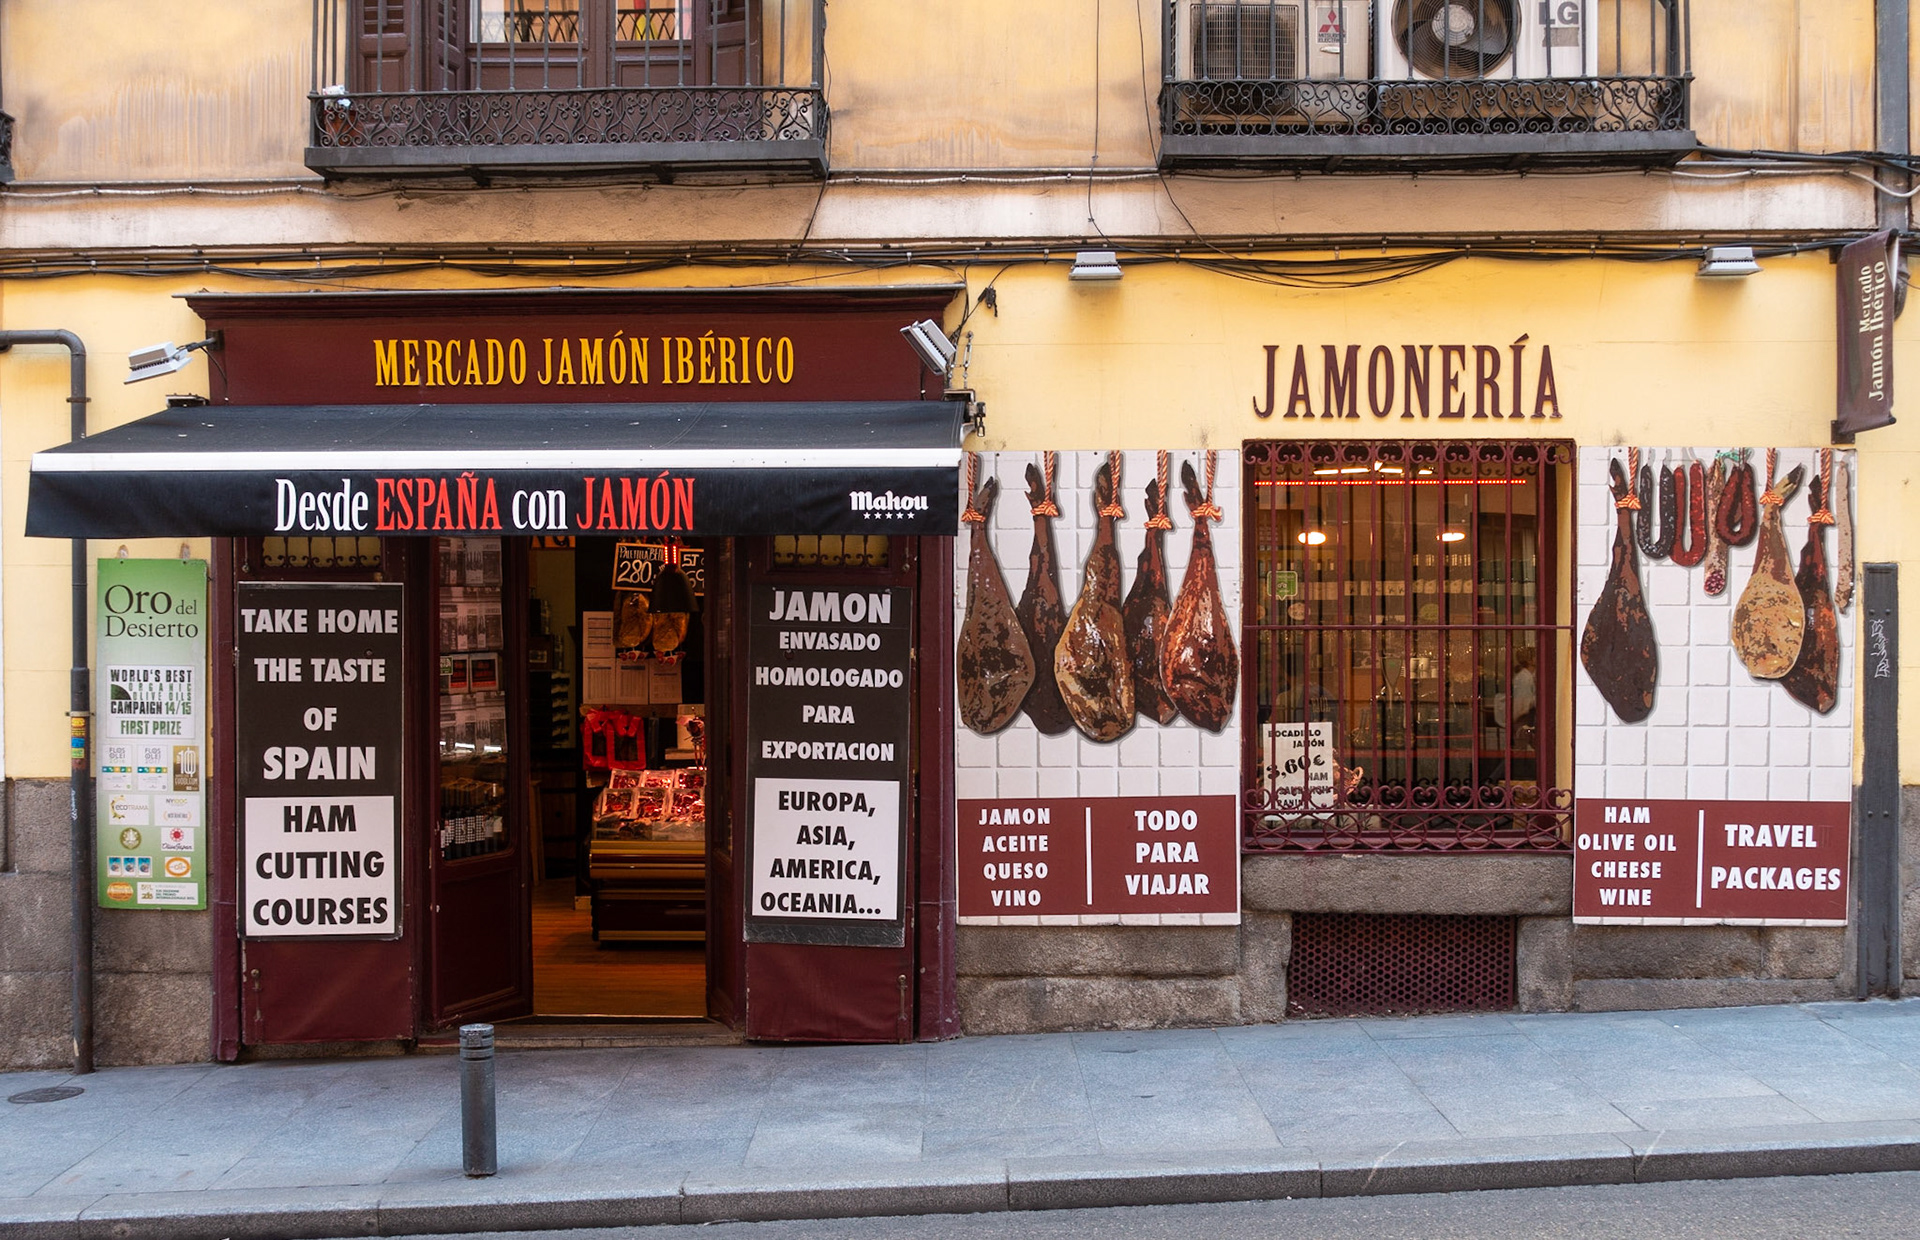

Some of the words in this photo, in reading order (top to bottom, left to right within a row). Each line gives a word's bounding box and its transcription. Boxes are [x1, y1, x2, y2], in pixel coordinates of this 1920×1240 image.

[1539, 2, 1579, 25] LG
[1858, 265, 1871, 333] Mercado
[1870, 261, 1886, 332] Ibérico
[373, 338, 528, 387] MERCADO
[538, 330, 650, 386] JAMÓN
[661, 330, 795, 385] IBÉRICO
[1869, 335, 1883, 401] Jamón
[1252, 333, 1562, 421] JAMONERÍA
[275, 478, 369, 533] Desde
[375, 471, 502, 531] ESPAÑA
[512, 489, 568, 531] con
[575, 470, 695, 531] JAMÓN
[849, 490, 929, 510] Mahou
[105, 584, 172, 614] Oro
[175, 599, 198, 615] del
[769, 590, 892, 625] JAMON
[105, 615, 198, 638] Desierto
[241, 608, 309, 634] TAKE
[318, 608, 399, 634] HOME
[779, 631, 881, 652] ENVASADO
[166, 669, 192, 682] BEST
[254, 657, 302, 683] THE
[311, 657, 386, 683] TASTE
[755, 666, 904, 689] HOMOLOGADO
[128, 683, 192, 691] ORGANIC
[132, 692, 162, 701] OLIVE
[168, 692, 192, 701] OILS
[110, 701, 162, 714] CAMPAIGN
[165, 702, 192, 715] 14/15
[303, 706, 338, 732] OF
[802, 705, 855, 724] PARA
[120, 720, 149, 734] FIRST
[152, 721, 181, 735] PRIZE
[1268, 729, 1321, 738] BOCADILO
[761, 740, 895, 763] EXPORTACION
[1293, 738, 1325, 749] JAÓN
[263, 745, 376, 781] SPAIN
[778, 790, 876, 818] EUROPA,
[1604, 806, 1651, 824] HAM
[283, 804, 357, 833] HAM
[979, 807, 1051, 827] JAMON
[1135, 809, 1198, 832] TODO
[796, 824, 856, 851] ASIA,
[982, 835, 1049, 853] ACEITE
[1578, 833, 1635, 852] OLIVE
[1644, 833, 1677, 852] OIL
[1724, 824, 1817, 848] TRAVEL
[1135, 841, 1199, 864] PARA
[255, 851, 386, 880] CUTTING
[769, 857, 882, 886] AMERICA,
[983, 863, 1049, 882] QUESO
[1591, 860, 1662, 880] CHEESE
[1125, 873, 1210, 896] VIAJAR
[1710, 866, 1841, 891] PACKAGES
[760, 892, 882, 915] OCEANIA...
[991, 889, 1041, 908] VINO
[1599, 887, 1652, 907] WINE
[252, 897, 389, 926] COURSES
